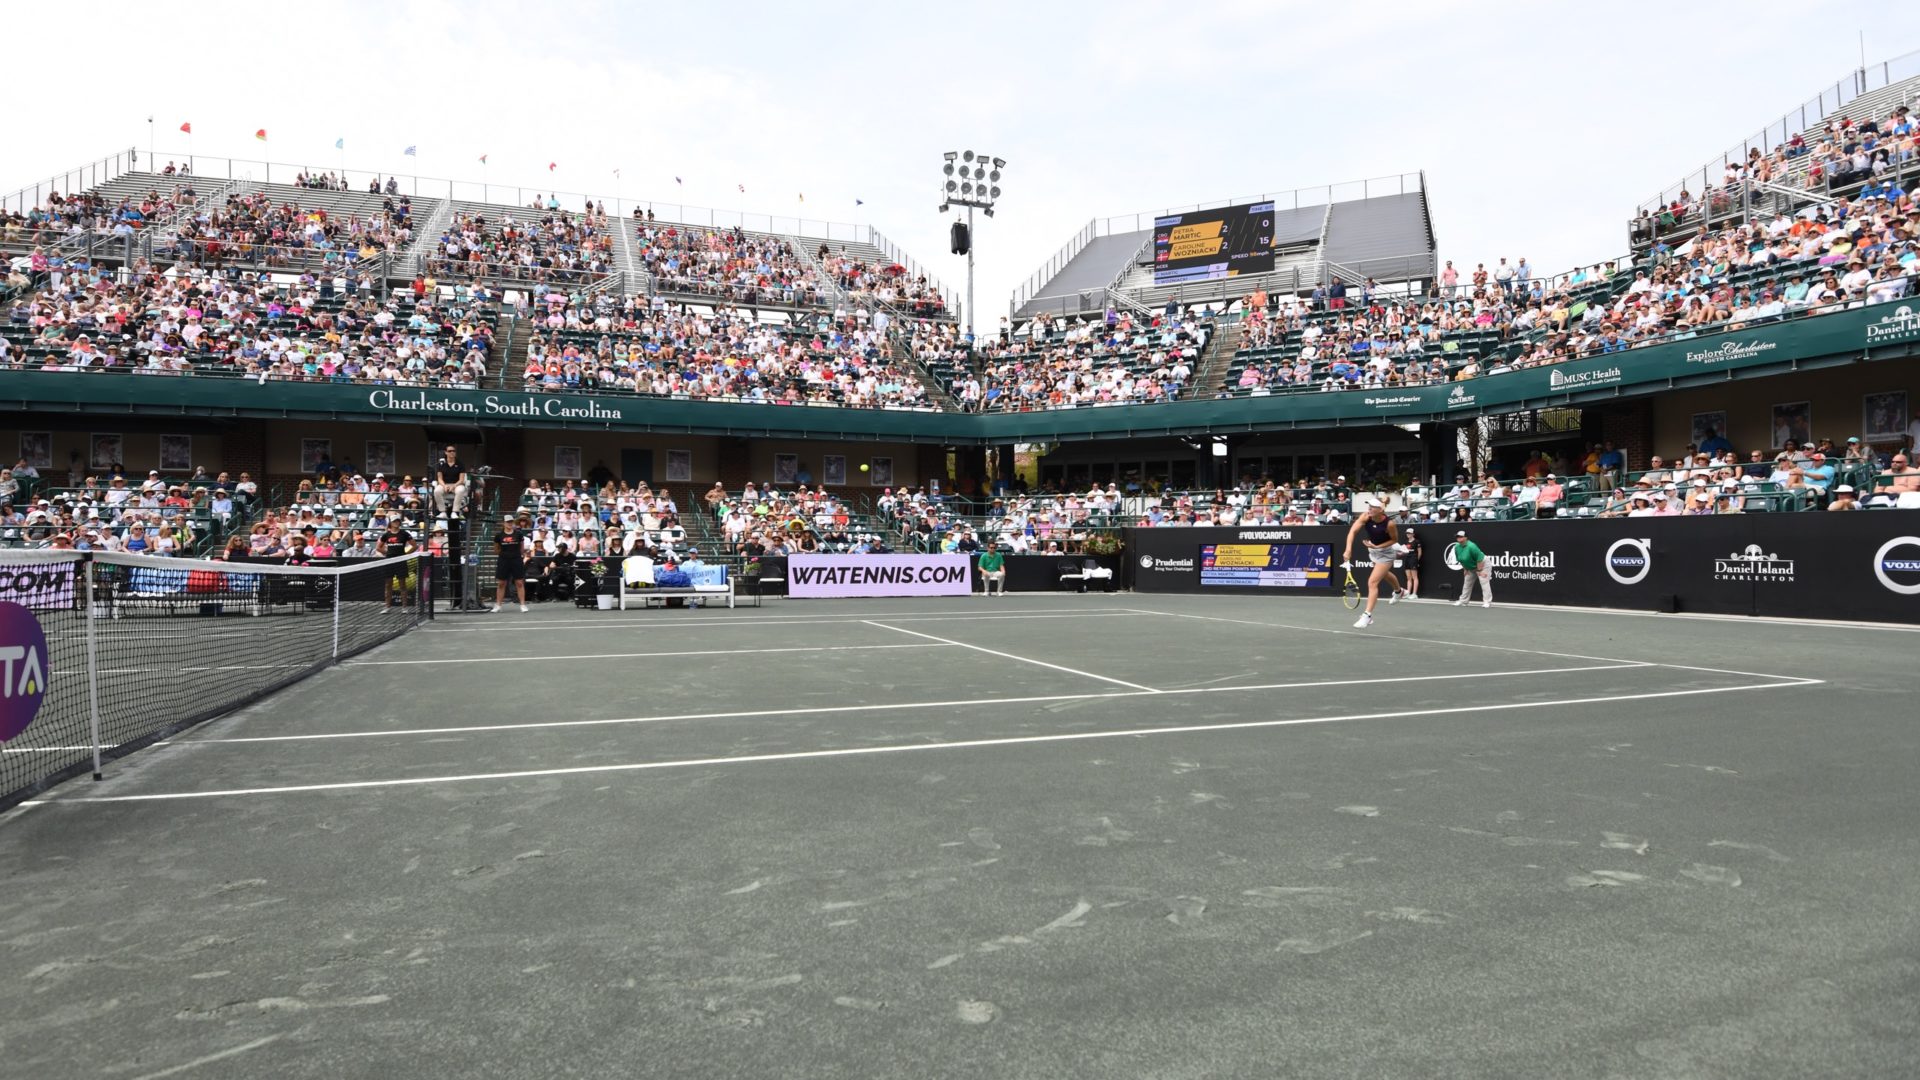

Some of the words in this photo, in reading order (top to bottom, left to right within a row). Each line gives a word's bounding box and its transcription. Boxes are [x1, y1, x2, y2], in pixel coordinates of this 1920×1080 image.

[1262, 219, 1269, 228] 0
[1223, 225, 1228, 233] 2
[1174, 232, 1201, 240] MARTIC
[1260, 236, 1269, 245] 15
[1223, 241, 1228, 250] 2
[1174, 247, 1217, 257] WOZNIACKI
[1867, 320, 1904, 337] Daniel
[1866, 330, 1918, 343] CHARLES
[1686, 349, 1724, 363] Explore
[1721, 340, 1776, 356] Charleston
[1704, 356, 1724, 364] SOUTH
[1726, 351, 1758, 360] CAROLINA
[1563, 372, 1591, 385] MUSC
[1592, 367, 1621, 380] Health
[369, 390, 480, 414] Charleston,
[485, 396, 540, 416] South
[544, 399, 622, 419] Carolina
[1238, 531, 1292, 540] #VOLVOCAROPEN
[1272, 547, 1279, 555] 2
[1317, 546, 1325, 554] 0
[1155, 558, 1194, 567] Prudential
[1272, 558, 1279, 566] 2
[1314, 558, 1325, 566] 15
[1355, 559, 1374, 568] Inve
[1489, 550, 1555, 568] udential
[1715, 561, 1755, 574] Daniel
[1758, 561, 1794, 575] Island
[1884, 561, 1920, 569] VOLV
[792, 566, 966, 585] WTATENNIS.COM
[1494, 570, 1510, 580] Your
[1511, 570, 1556, 583] Challenges
[1714, 574, 1794, 582] CHARLESTON
[0, 645, 44, 698] TA
